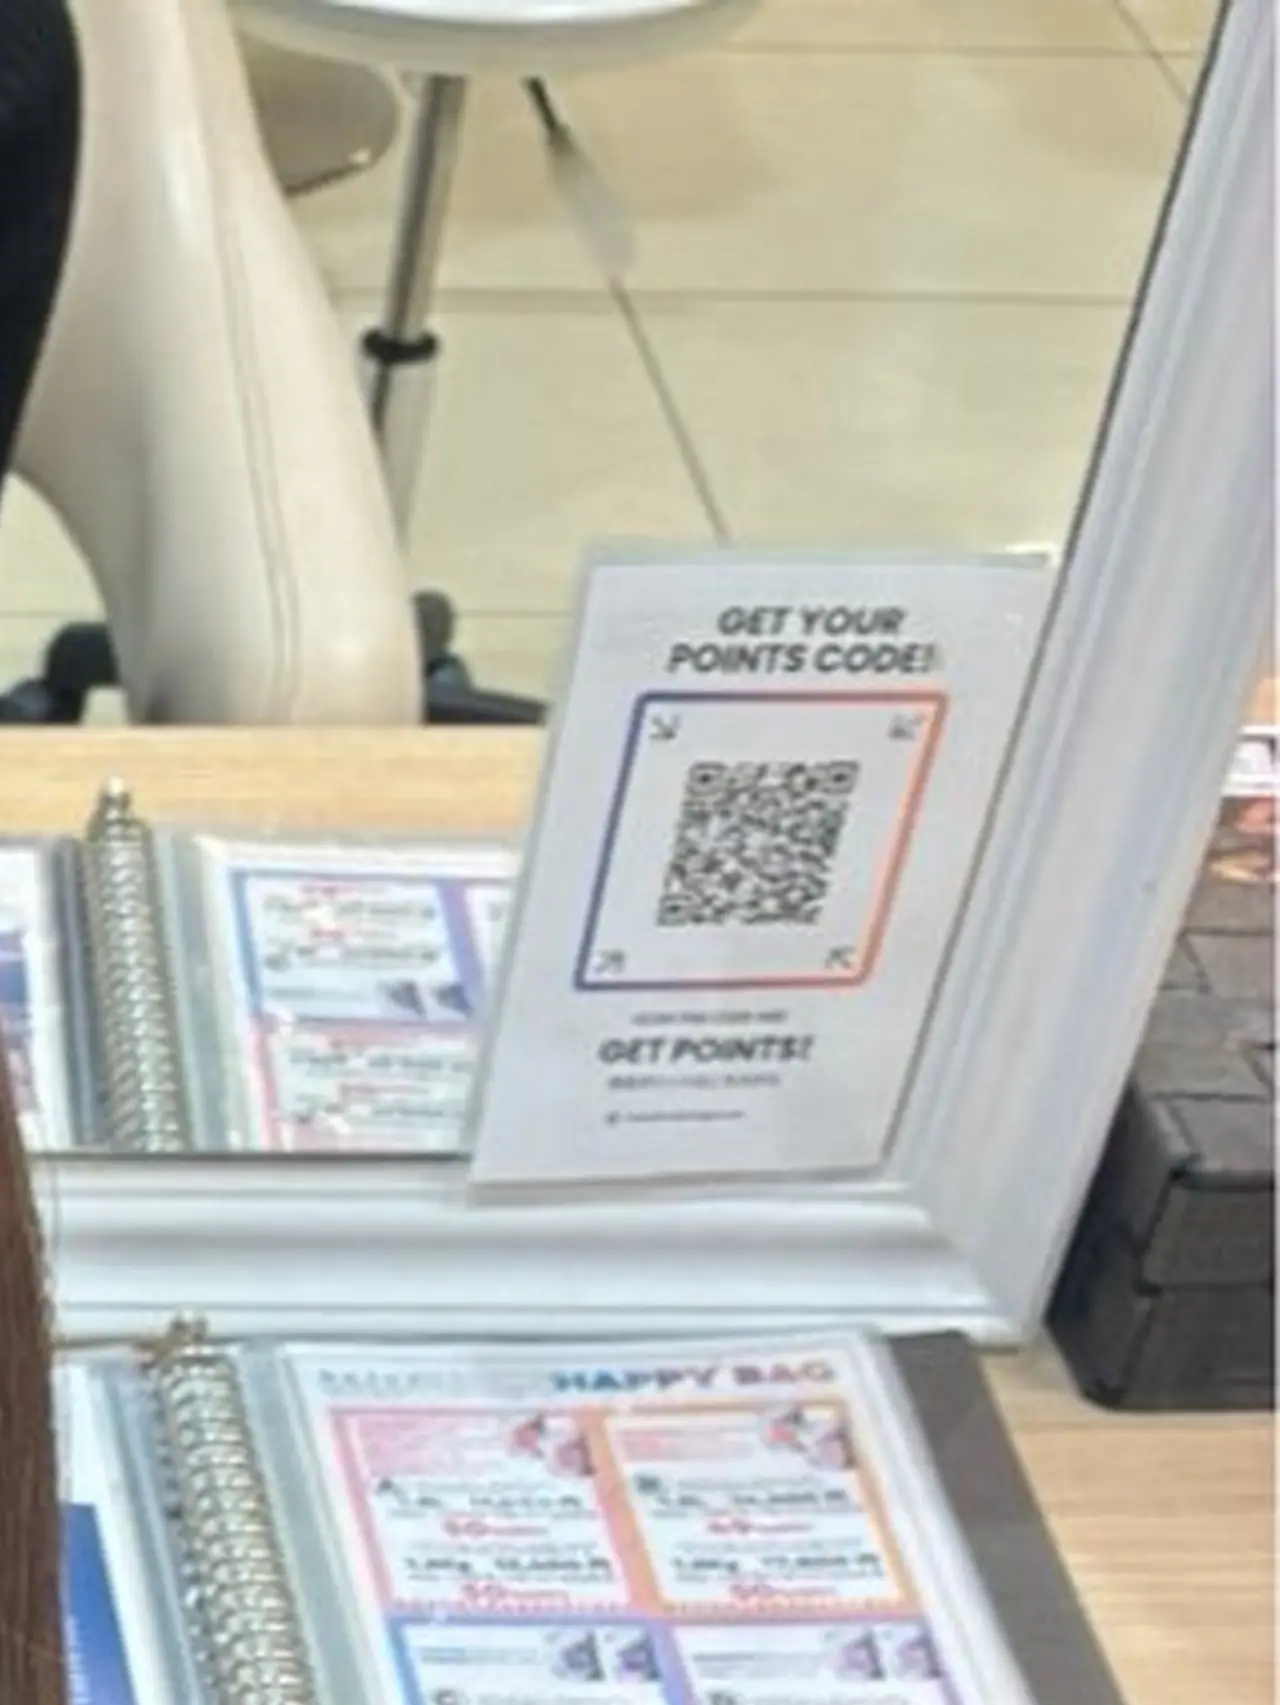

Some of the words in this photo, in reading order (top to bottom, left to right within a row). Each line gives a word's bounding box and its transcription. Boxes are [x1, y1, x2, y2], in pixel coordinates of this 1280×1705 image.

[717, 605, 791, 636] GET
[799, 604, 907, 636] YOUR
[666, 643, 807, 674] POINTS
[813, 642, 937, 674] CODE!
[598, 1037, 664, 1064] GET
